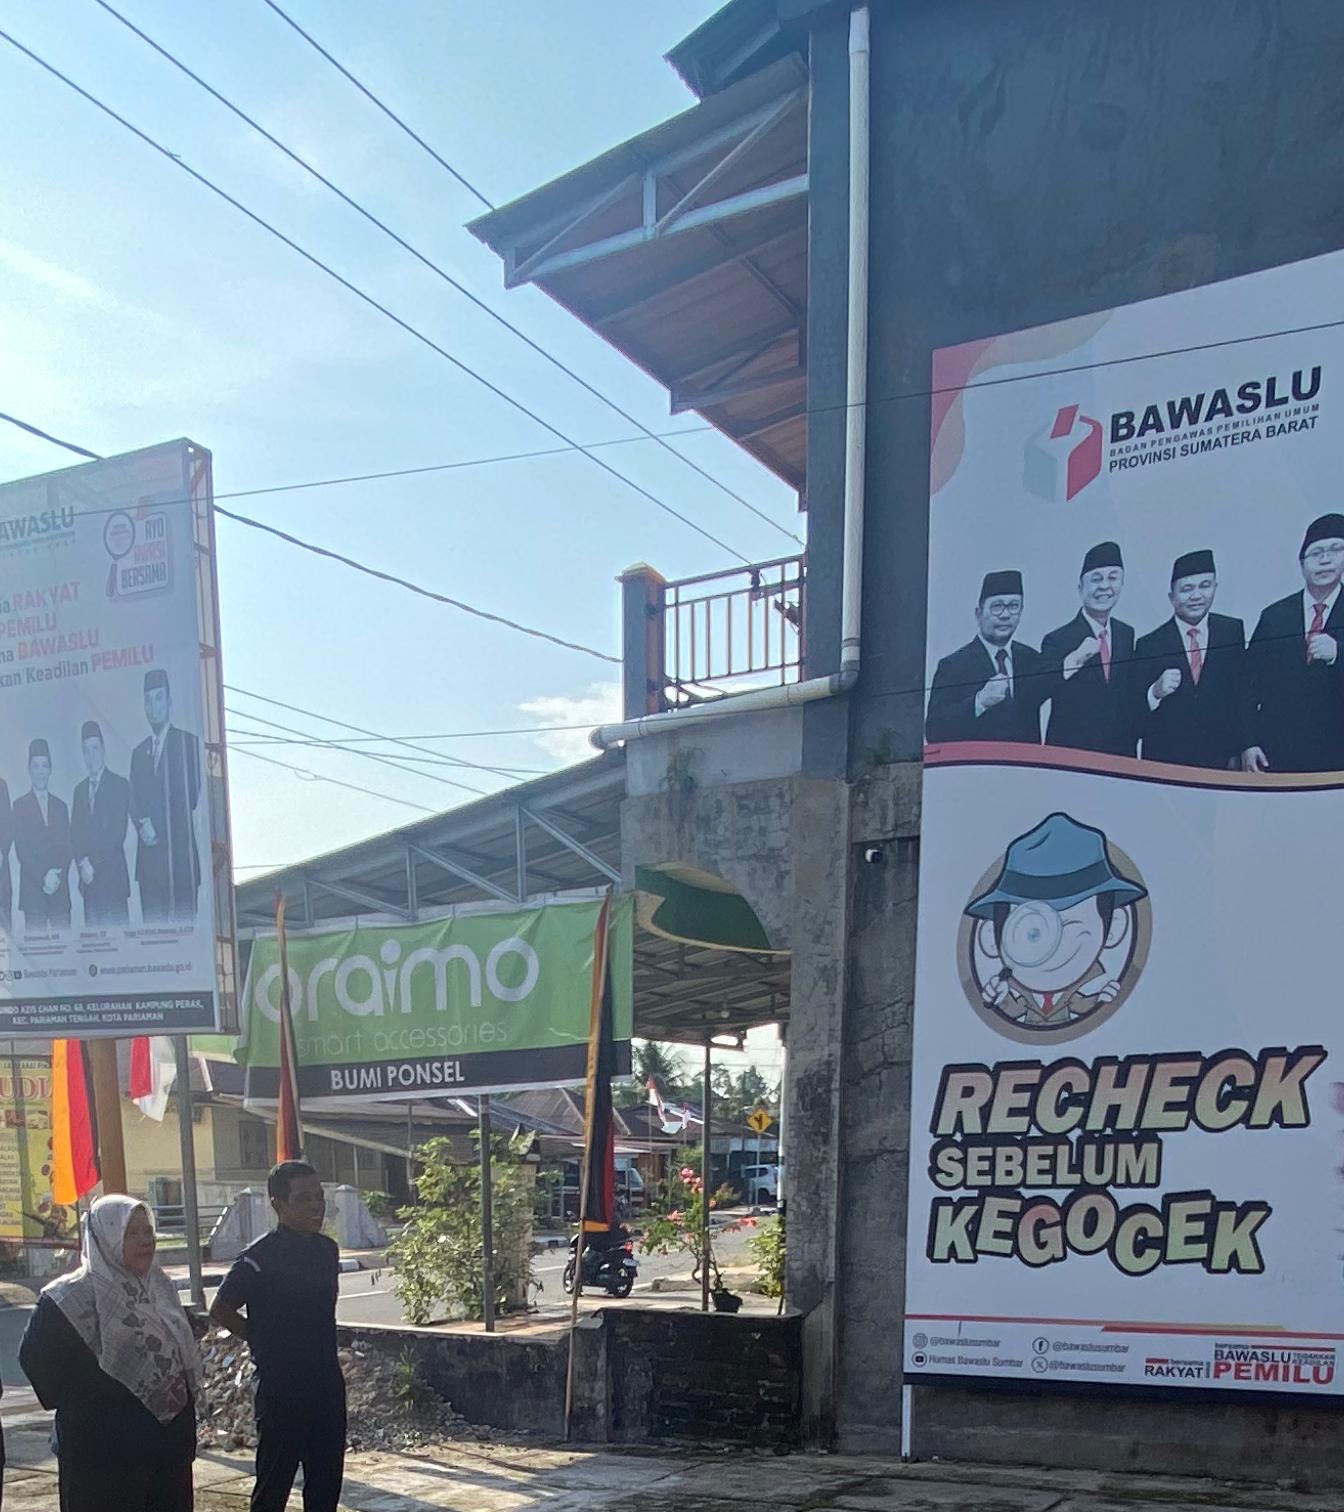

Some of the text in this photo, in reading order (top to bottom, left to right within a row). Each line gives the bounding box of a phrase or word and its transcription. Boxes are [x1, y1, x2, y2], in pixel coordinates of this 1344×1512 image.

[1110, 366, 1321, 443] BAWASLU
[1109, 403, 1320, 457] BADAN PENGAWAS PEMILIHAN UMUM
[1109, 416, 1318, 473] PROVINSI SUMATERA BARAT
[121, 562, 166, 589] BERSAMA
[12, 581, 81, 611] RAKYAT
[17, 627, 99, 660] BAWASLU
[26, 659, 88, 683] Keadilan
[91, 643, 154, 673] PEMILU
[256, 936, 540, 1023] oraimo
[299, 1021, 507, 1058] smart accessories
[331, 1061, 465, 1090] BUMI PONSEL
[933, 1047, 1327, 1137] RECHECK
[930, 1137, 1161, 1190] SEBELUM
[927, 1192, 1272, 1275] KEGOCEK
[1144, 1365, 1203, 1378] RAKYAT
[1213, 1361, 1334, 1385] PEMILU
[1214, 1349, 1291, 1363] BAWASLU
